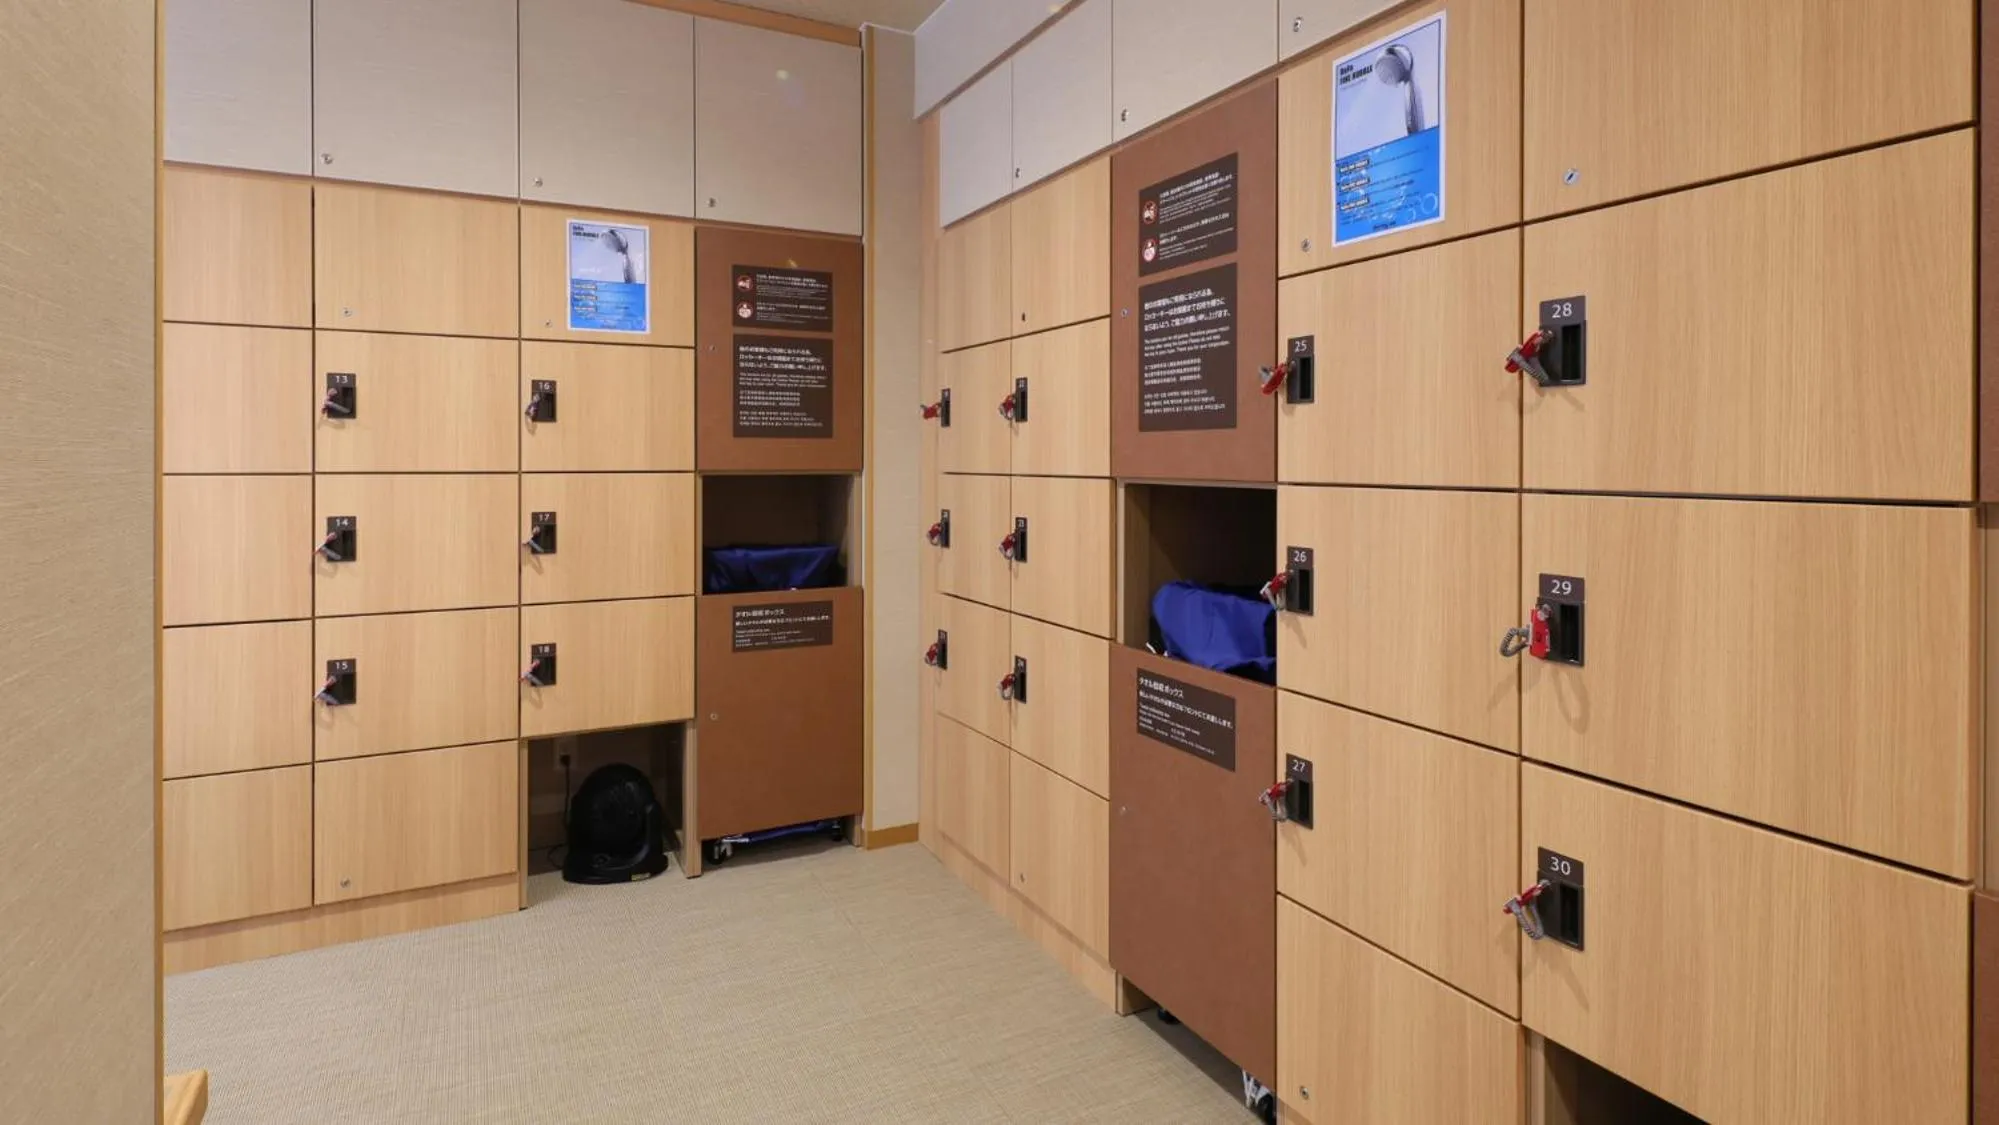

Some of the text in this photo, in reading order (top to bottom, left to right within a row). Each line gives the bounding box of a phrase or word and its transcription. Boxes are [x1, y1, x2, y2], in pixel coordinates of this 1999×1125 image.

[1551, 303, 1572, 318] 28
[1294, 340, 1307, 353] 25
[336, 375, 348, 384] 13
[539, 382, 550, 391] 16
[336, 518, 348, 527] 14
[539, 513, 550, 522] 17
[1293, 550, 1307, 562] 26
[1551, 579, 1572, 595] 29
[539, 645, 550, 654] 18
[336, 661, 348, 670] 15
[1292, 759, 1305, 773] 27
[1550, 856, 1571, 875] 30
